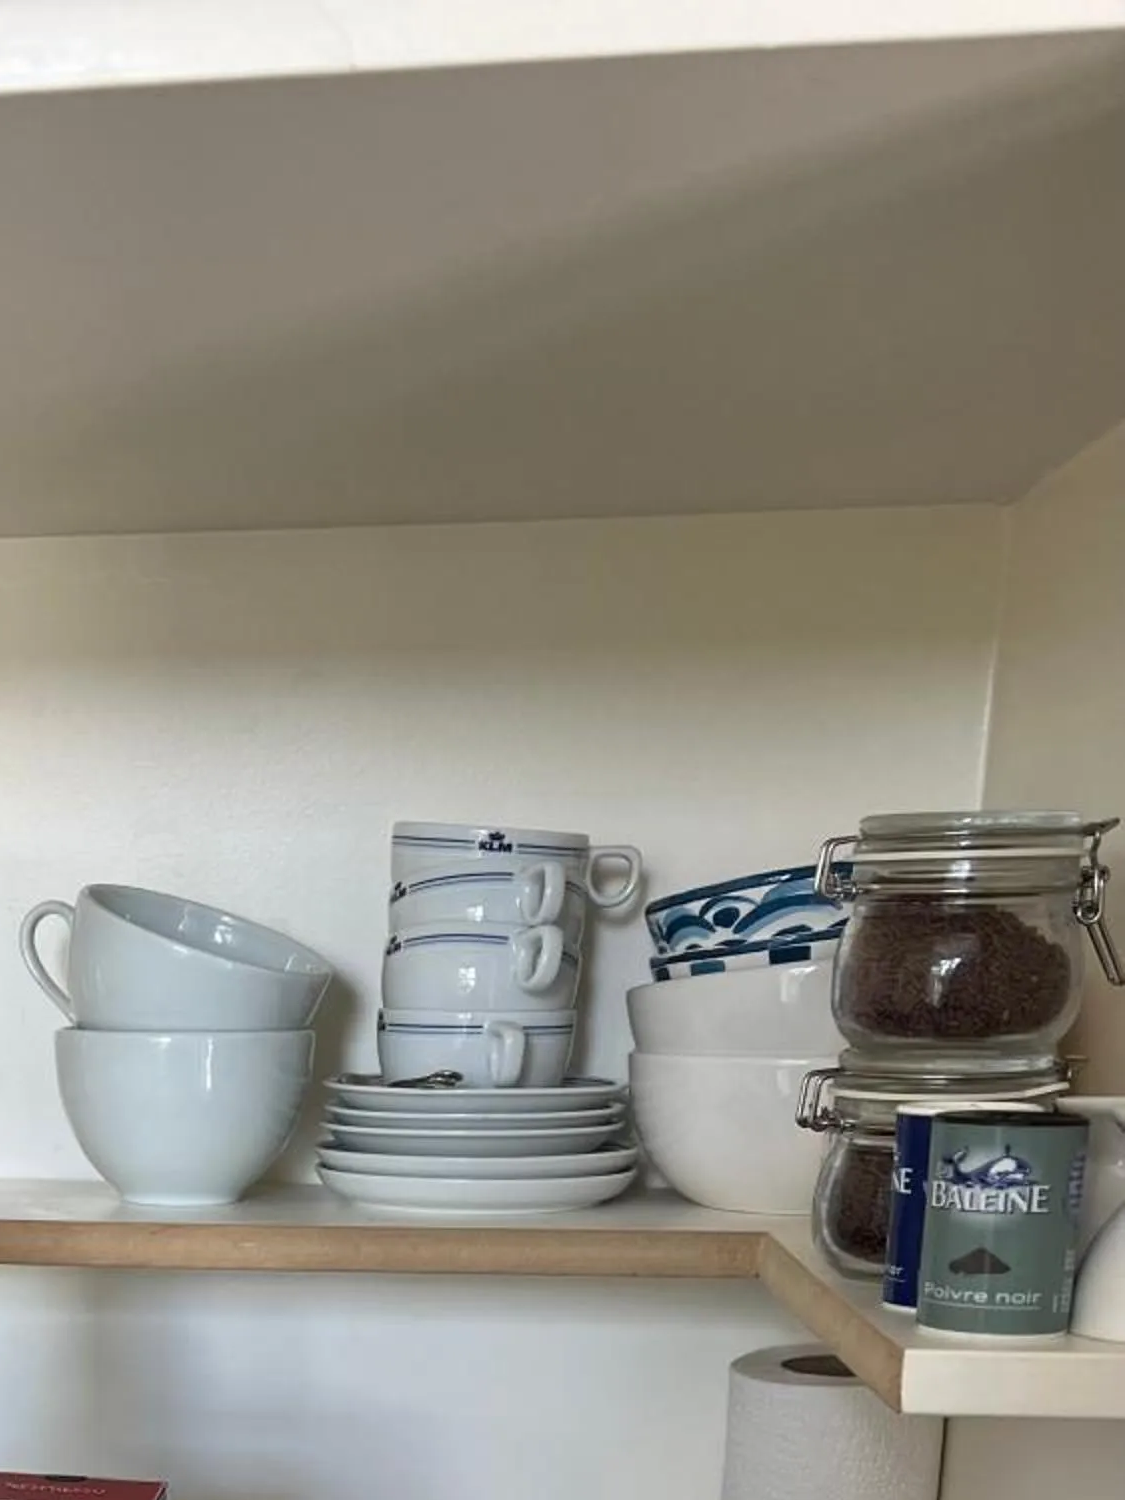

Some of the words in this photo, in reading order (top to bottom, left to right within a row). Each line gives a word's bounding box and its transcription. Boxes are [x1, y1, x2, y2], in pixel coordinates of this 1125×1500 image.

[478, 841, 513, 853] KLM
[931, 1180, 1051, 1213] BALEINE
[922, 1281, 989, 1304] Poivre
[994, 1288, 1043, 1305] noir
